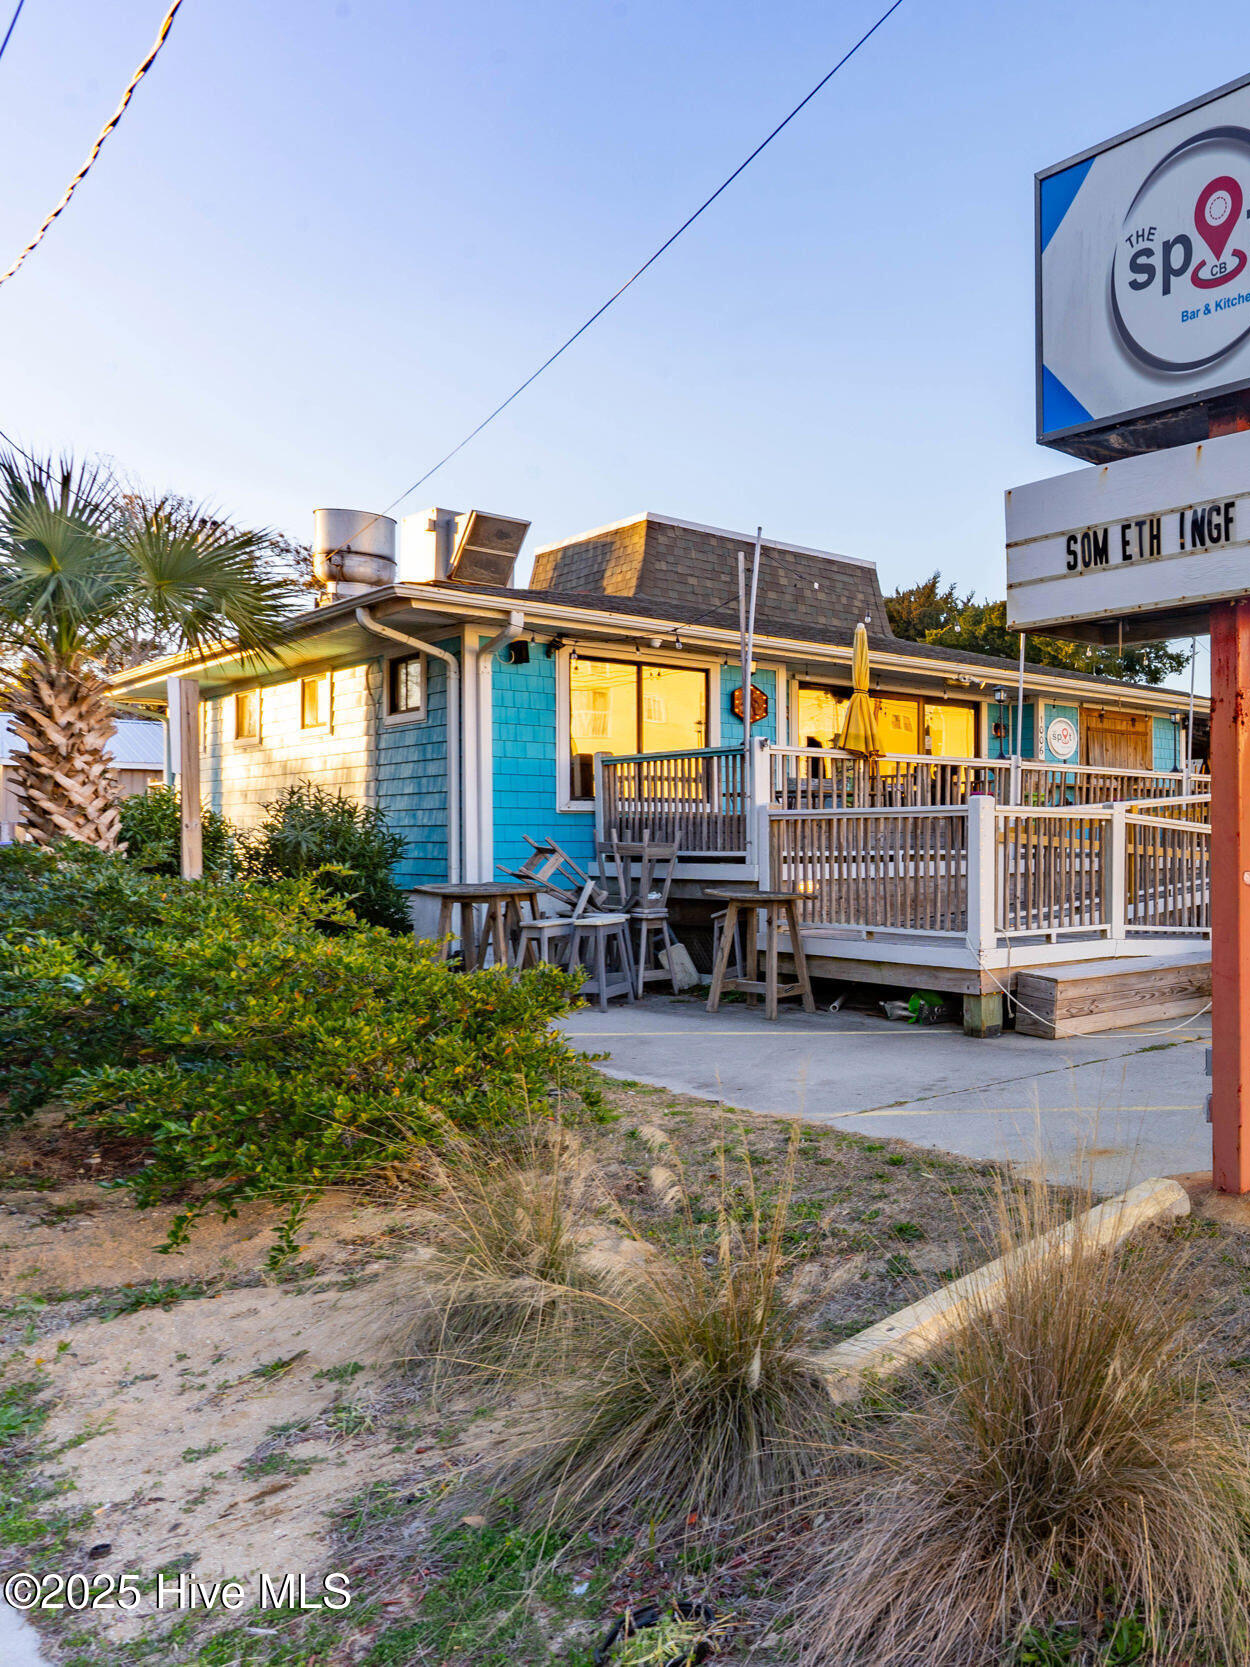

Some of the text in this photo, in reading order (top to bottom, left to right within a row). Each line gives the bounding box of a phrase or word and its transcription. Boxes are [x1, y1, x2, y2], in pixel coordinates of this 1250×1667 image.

[1125, 226, 1157, 249] THE
[1210, 262, 1227, 277] CB
[1181, 309, 1200, 323] Bar
[1203, 303, 1212, 316] &
[1066, 528, 1109, 571] SOM
[1121, 517, 1162, 562] ETH
